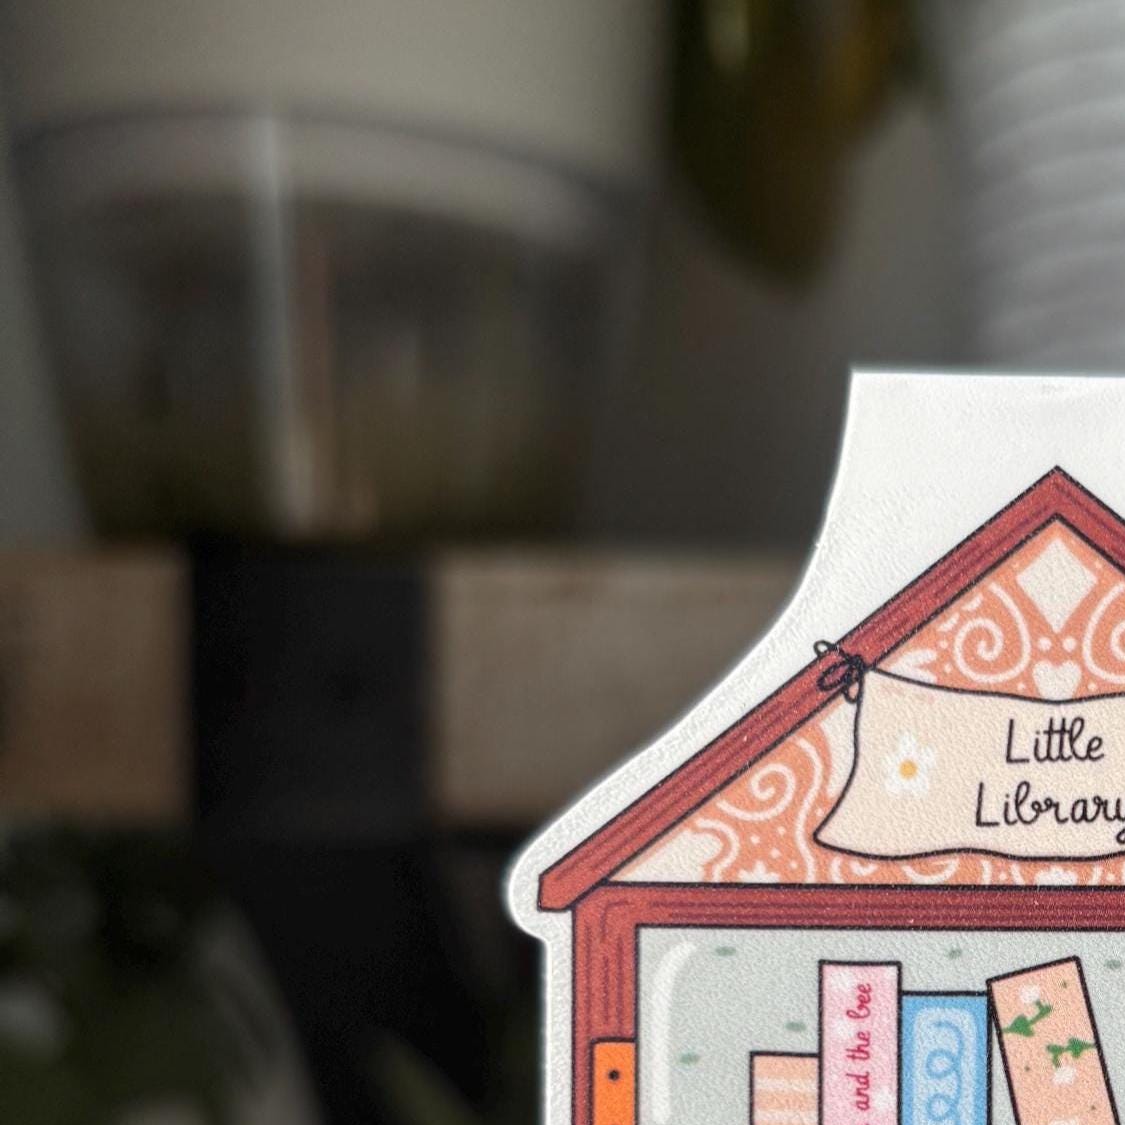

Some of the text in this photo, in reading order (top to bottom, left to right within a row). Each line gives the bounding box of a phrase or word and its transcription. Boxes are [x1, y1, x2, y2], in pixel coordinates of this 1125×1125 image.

[1005, 716, 1105, 764] Little
[845, 982, 873, 1021] bee
[845, 1030, 871, 1067] the
[845, 1070, 871, 1111] and
